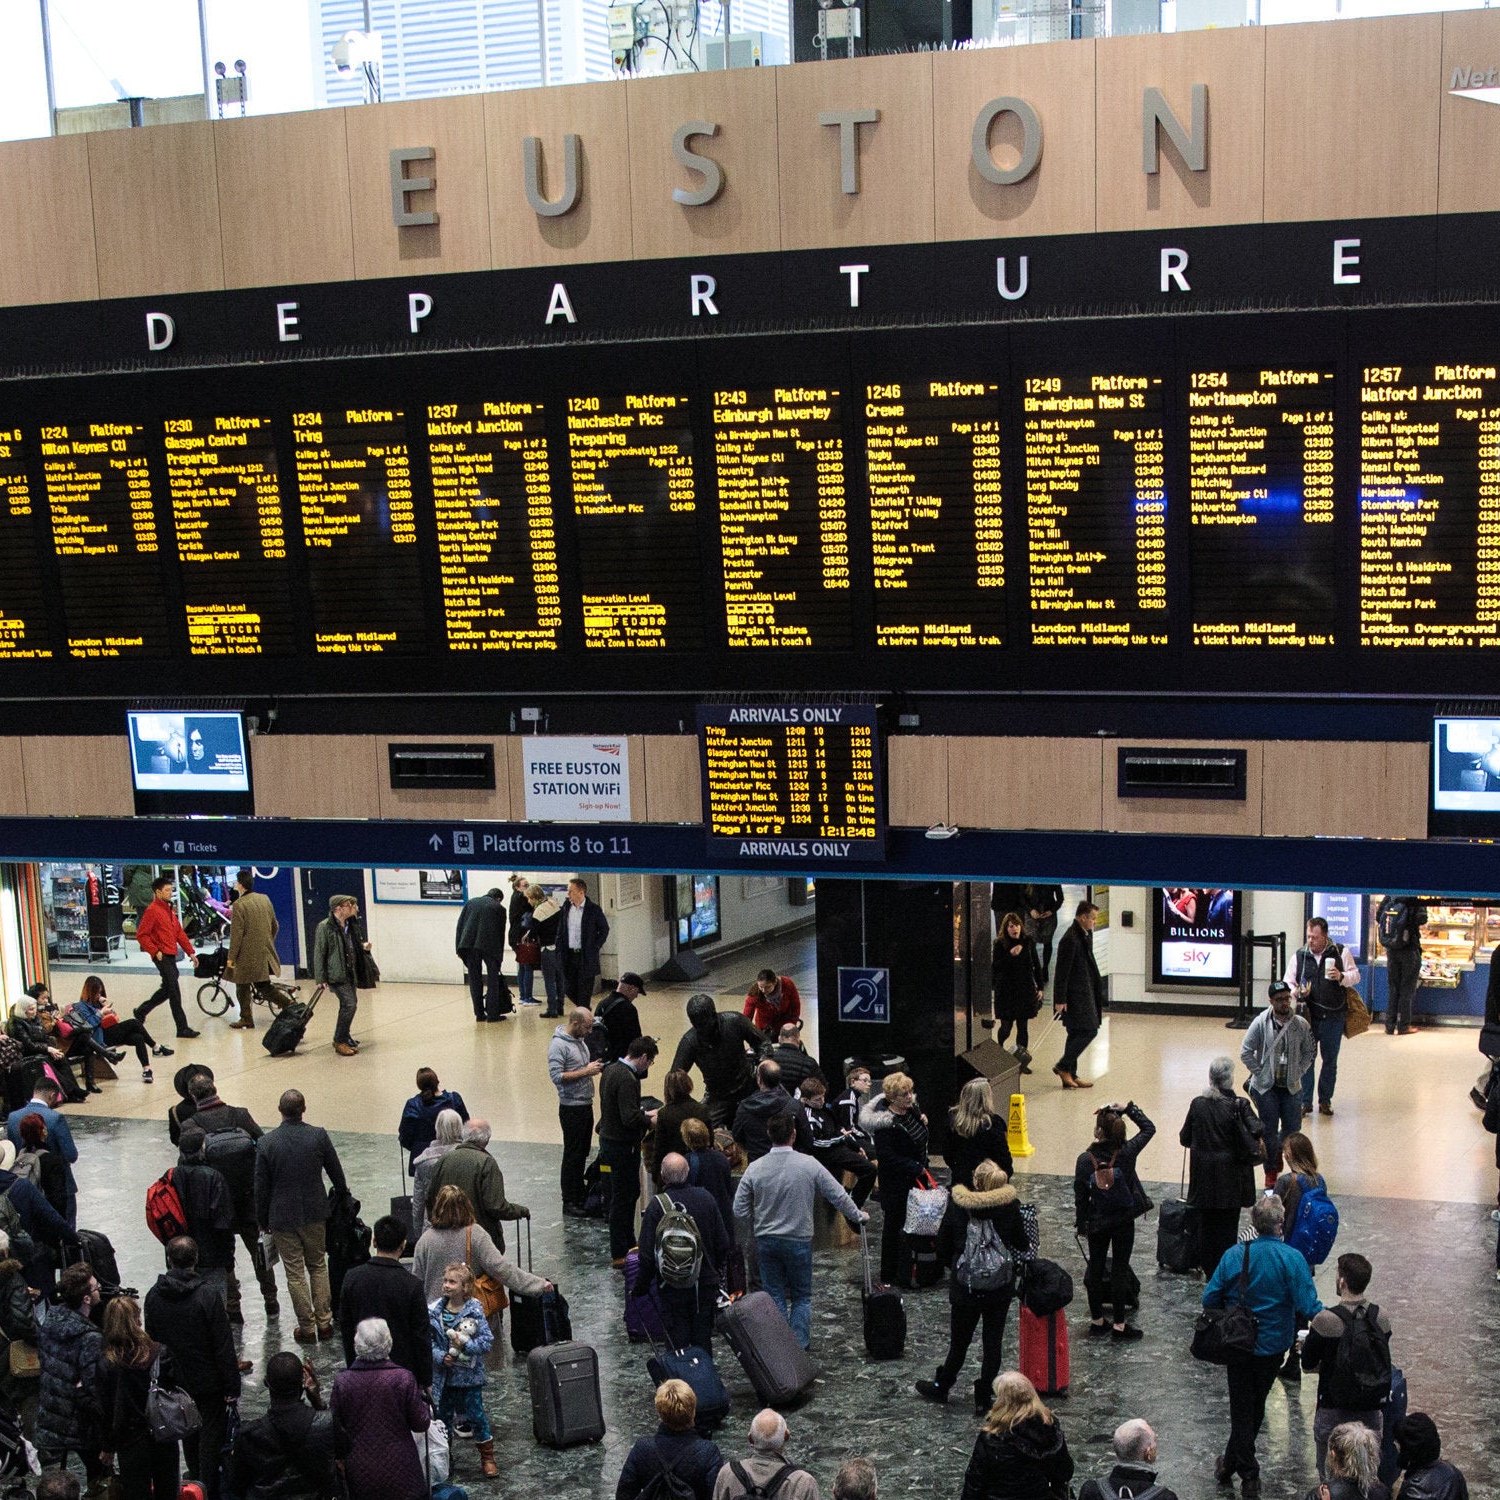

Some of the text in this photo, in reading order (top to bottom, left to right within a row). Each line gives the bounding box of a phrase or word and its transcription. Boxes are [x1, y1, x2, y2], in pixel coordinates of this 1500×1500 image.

[390, 82, 1210, 228] EUSTON
[1190, 392, 1276, 407] Northampton
[714, 406, 830, 423] Edinburgh Waverley
[866, 404, 904, 418] Crewe
[165, 433, 247, 449] Glasgow Central
[294, 430, 323, 443] Tring
[571, 445, 678, 458] Boarding approximately 12:22
[167, 452, 217, 465] Preparing
[729, 708, 842, 722] ARRIVALS ONLY
[706, 726, 726, 736] Tring
[814, 727, 823, 735] 10
[850, 727, 870, 735] 12:10
[707, 738, 737, 746] Watford
[740, 738, 772, 746] Junction
[787, 738, 805, 746] 12:11
[851, 738, 871, 746] 12:12
[531, 763, 620, 775] FREE EUSTON
[533, 783, 620, 795] STATION WiFi
[713, 825, 876, 838] Page 1 of 2 12:12:48
[188, 842, 217, 852] Tickets
[483, 834, 631, 854] Platforms 8 to 11
[739, 842, 850, 856] ARRIVALS ONLY
[1170, 927, 1225, 938] BILLIONS
[1183, 949, 1210, 965] sky
